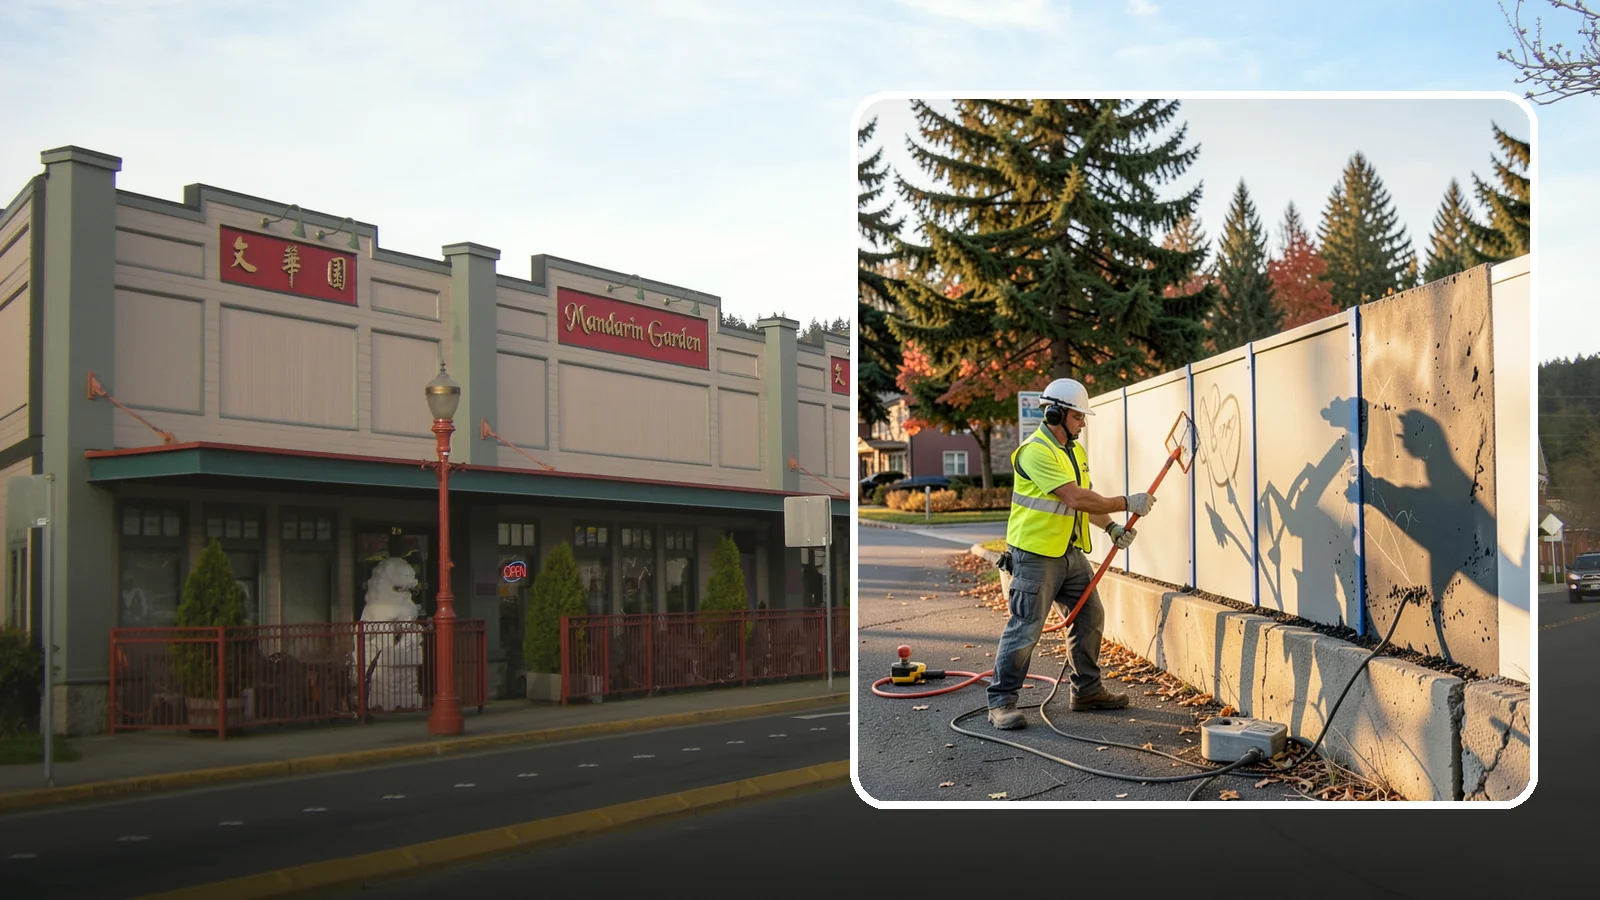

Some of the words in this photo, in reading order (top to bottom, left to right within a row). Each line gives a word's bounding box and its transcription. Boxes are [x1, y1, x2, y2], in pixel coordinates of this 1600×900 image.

[564, 302, 644, 341] Mandarin
[648, 321, 702, 352] Garden
[503, 565, 527, 578] OPEN
